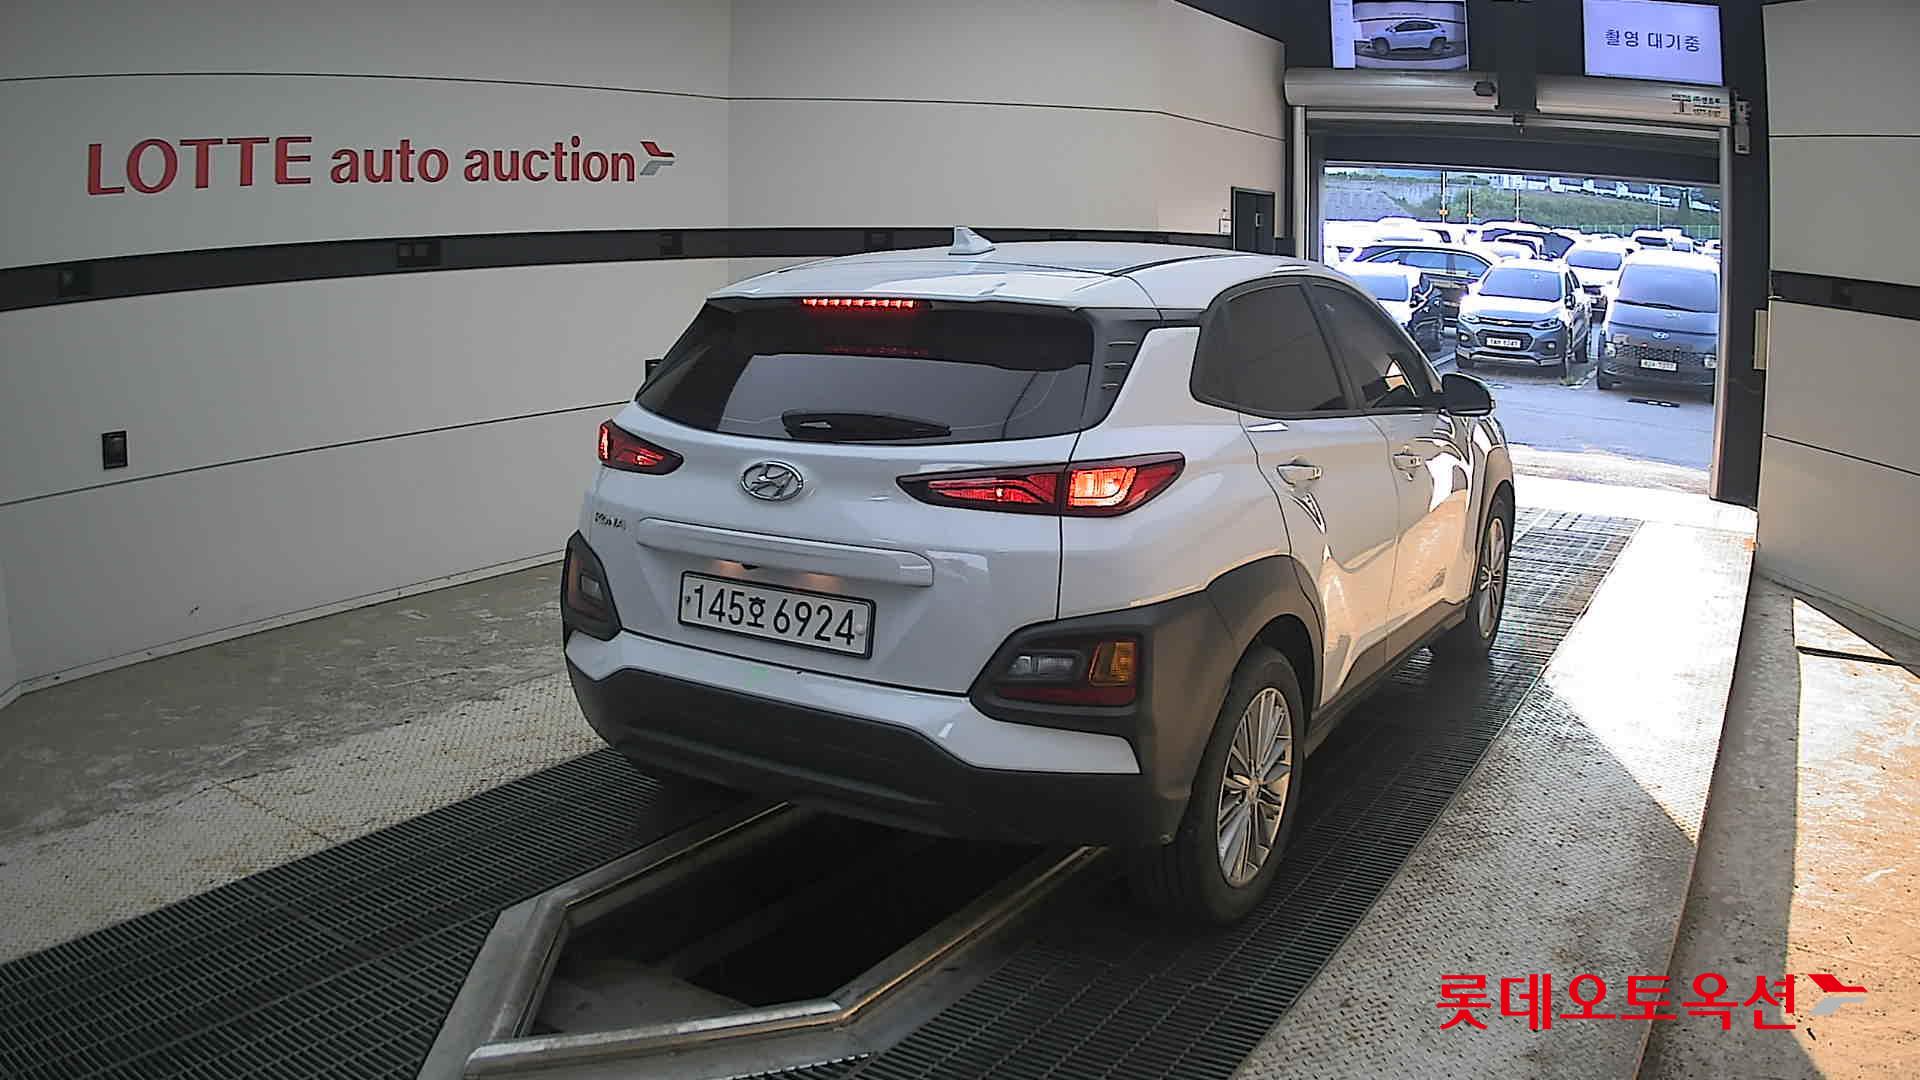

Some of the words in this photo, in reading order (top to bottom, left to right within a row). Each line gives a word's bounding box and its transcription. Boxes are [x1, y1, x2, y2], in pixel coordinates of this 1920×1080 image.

[1604, 28, 1640, 48] 촬영
[1647, 32, 1701, 53] 대기중
[87, 136, 312, 196] LOTTE
[330, 138, 449, 184] auto
[463, 135, 636, 183] auction
